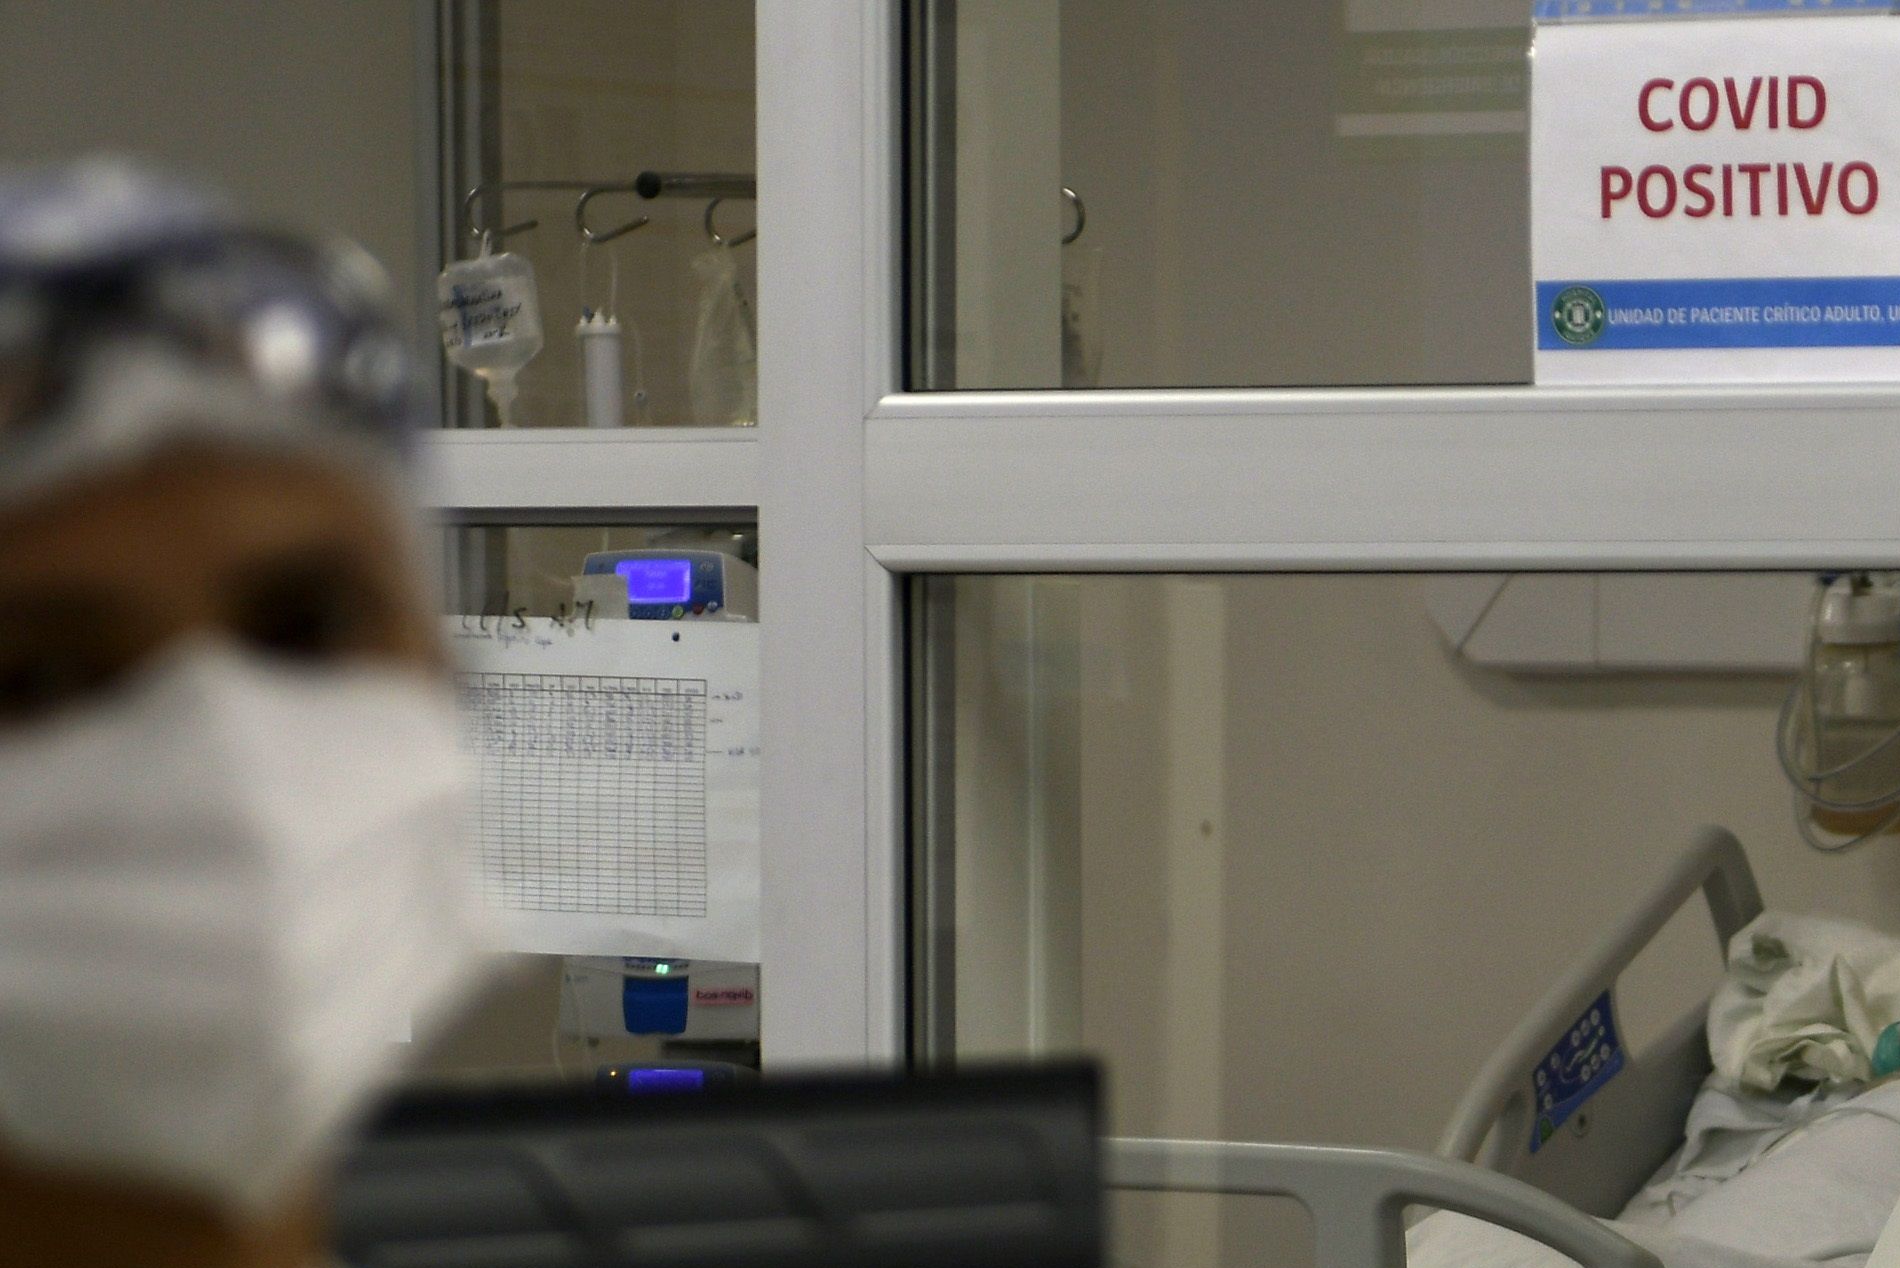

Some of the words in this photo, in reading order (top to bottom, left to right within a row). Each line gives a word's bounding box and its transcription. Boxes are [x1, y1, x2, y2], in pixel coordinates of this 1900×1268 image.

[1638, 75, 1826, 132] COVID
[1600, 160, 1880, 219] POSITIVO
[1608, 307, 1664, 325] UNIDAD
[1667, 307, 1688, 324] DE
[1691, 306, 1760, 323] PACIENTE
[1763, 302, 1821, 322] CRÍTICO
